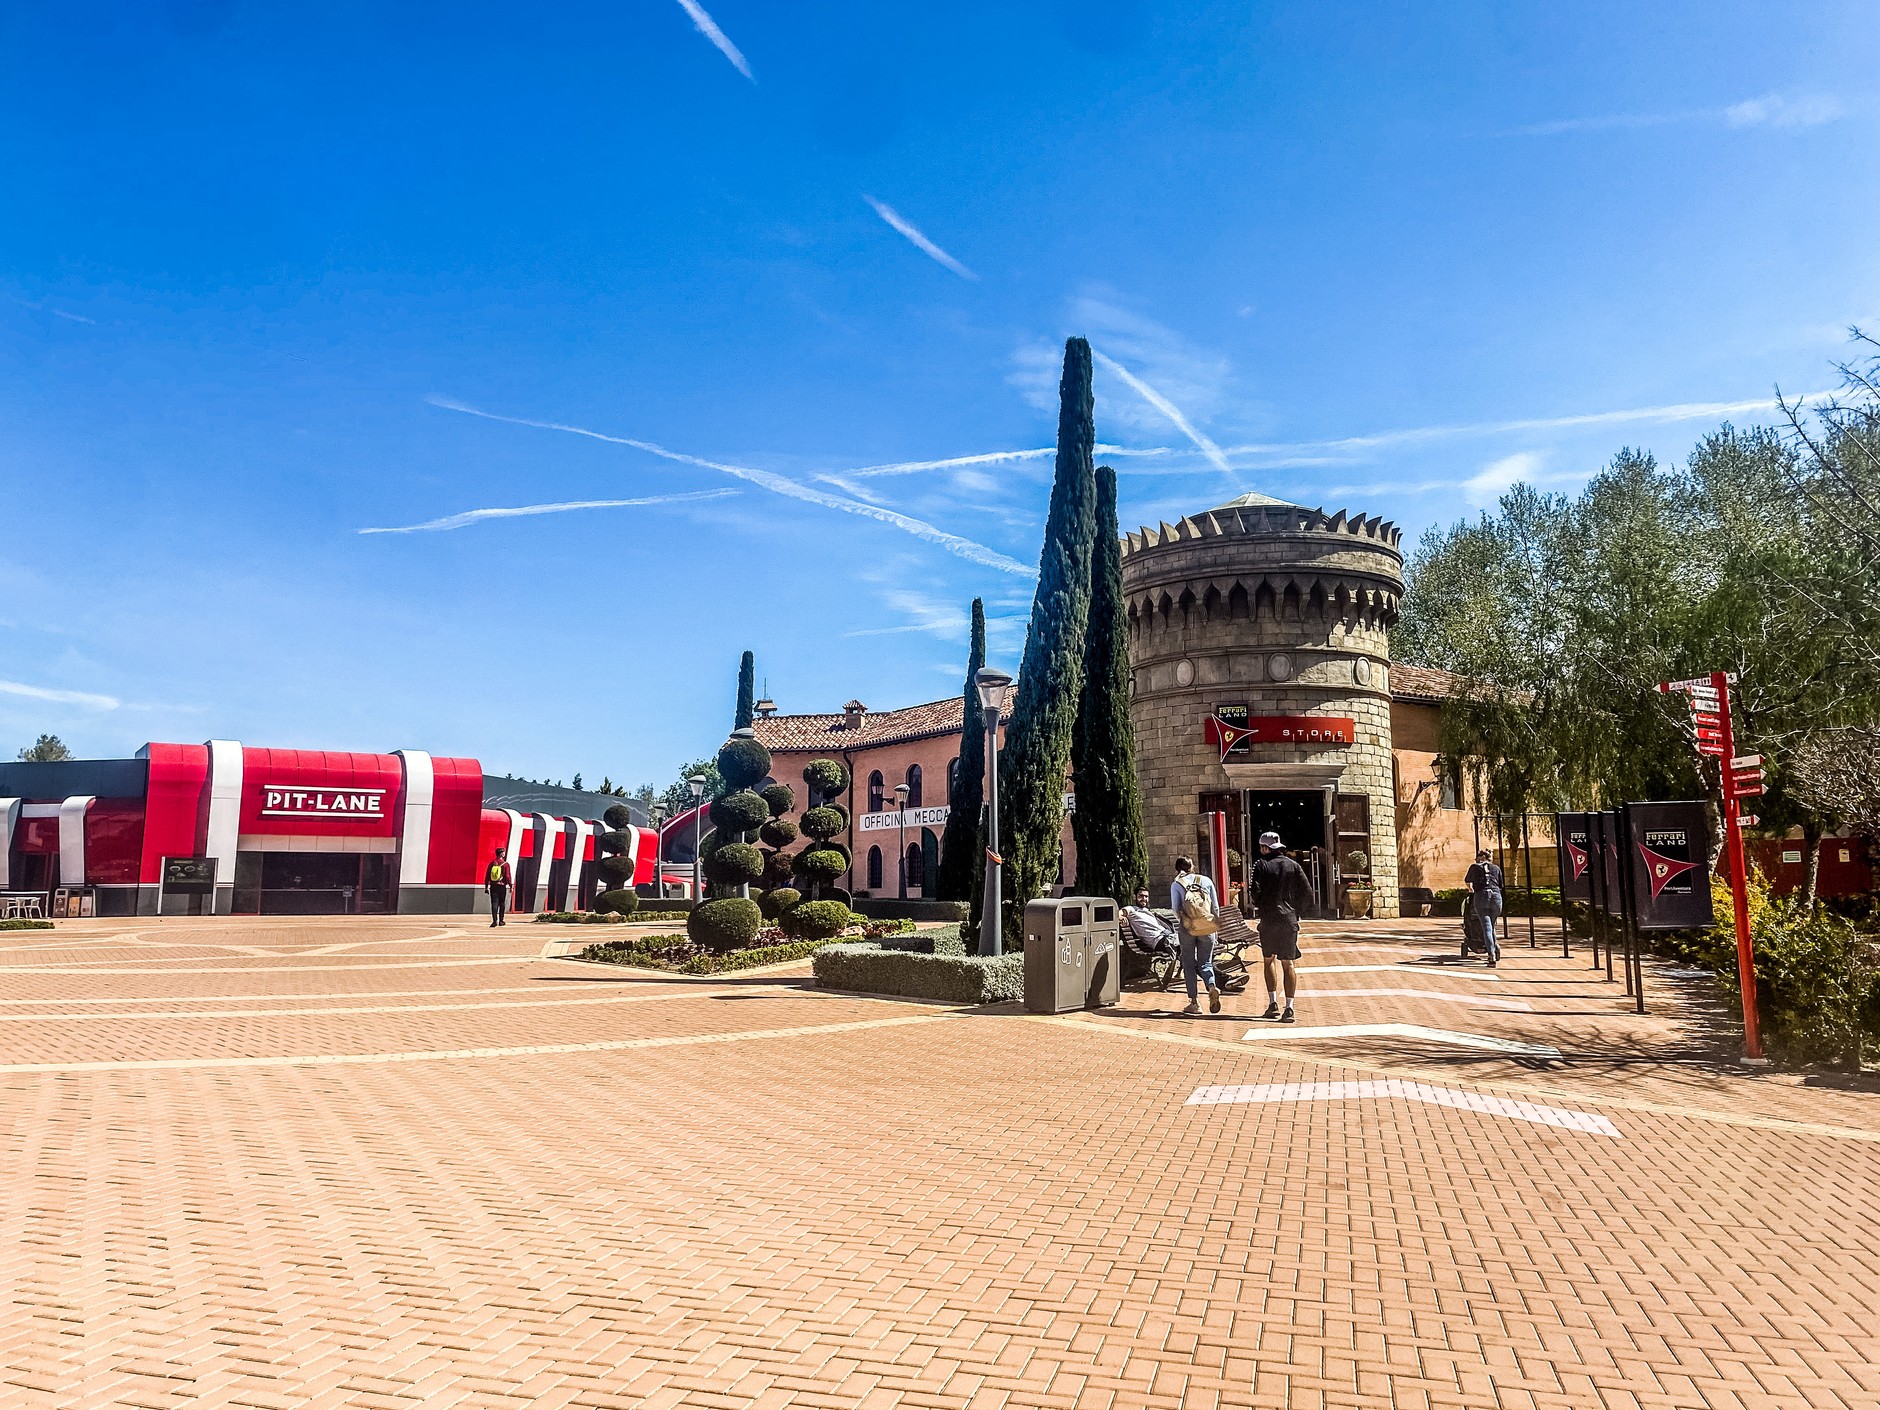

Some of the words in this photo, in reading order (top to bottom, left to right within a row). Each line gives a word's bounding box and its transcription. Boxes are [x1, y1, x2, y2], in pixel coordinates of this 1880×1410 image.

[1282, 729, 1344, 737] STORE
[266, 791, 381, 811] PIT-LANE
[914, 808, 949, 824] MECCA
[1645, 831, 1686, 840] Ferrari
